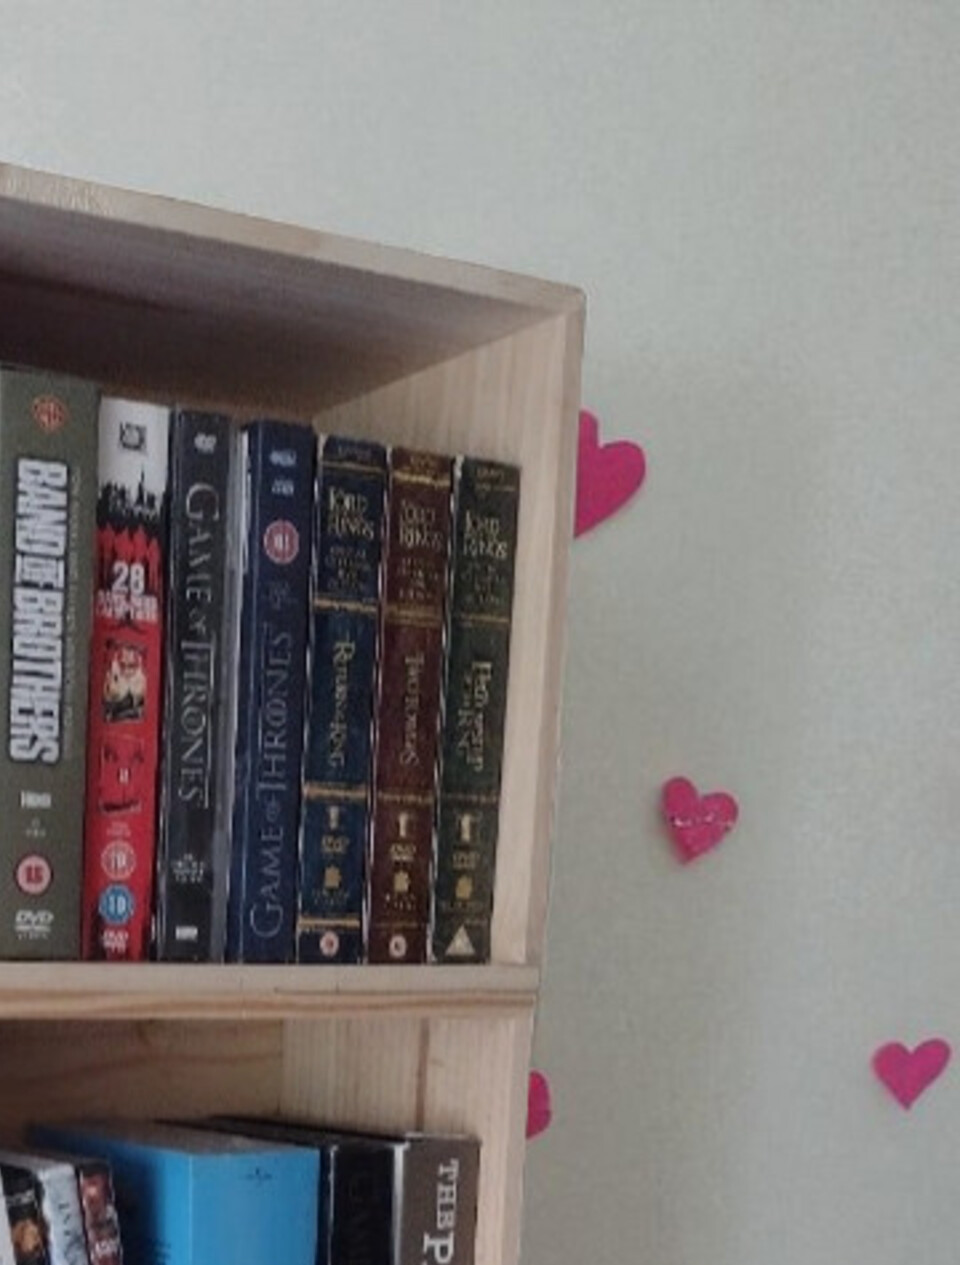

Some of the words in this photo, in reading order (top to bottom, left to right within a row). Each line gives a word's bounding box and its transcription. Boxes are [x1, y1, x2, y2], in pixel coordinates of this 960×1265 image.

[15, 458, 69, 557] BAND
[185, 482, 221, 602] GAME
[14, 554, 66, 590] OF
[112, 561, 146, 595] 28
[10, 586, 66, 762] BROTHERS
[178, 630, 216, 808] THRONES
[256, 623, 291, 799] THRONES
[250, 826, 285, 938] GAME
[436, 1158, 460, 1231] THE
